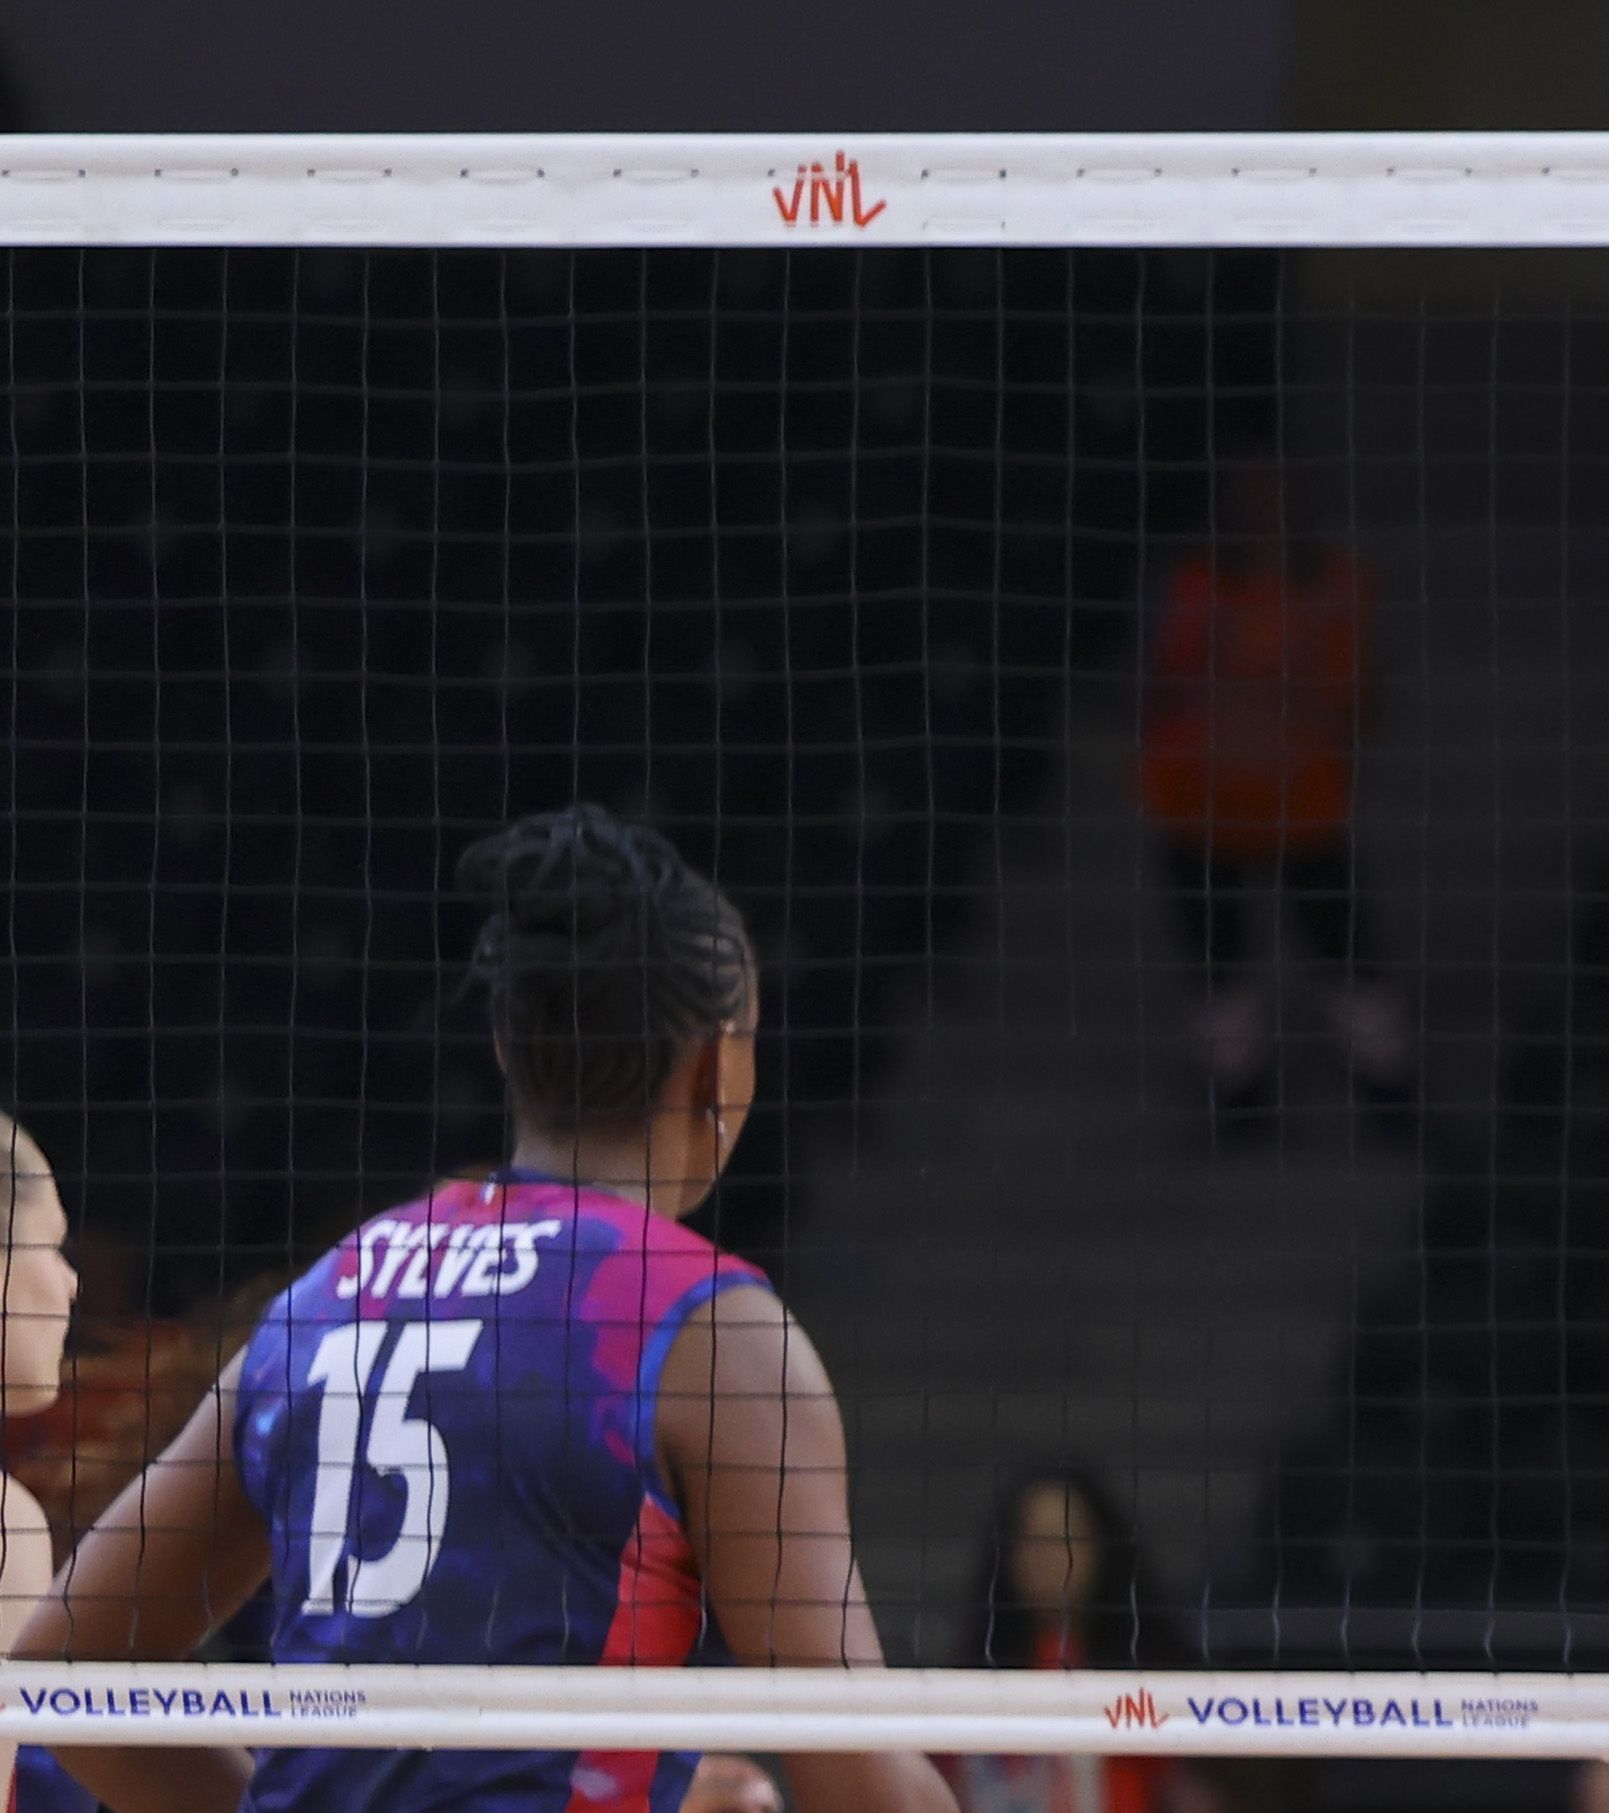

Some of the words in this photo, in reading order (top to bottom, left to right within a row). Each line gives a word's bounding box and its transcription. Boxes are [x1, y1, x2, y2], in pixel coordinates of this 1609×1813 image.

[772, 149, 887, 227] VNL
[335, 1219, 561, 1300] SYLVES
[302, 1318, 482, 1618] 15
[19, 1687, 282, 1717] VOLLEYBALL
[289, 1689, 366, 1705] NATIONS
[290, 1704, 358, 1718] LEAGUE
[1104, 1687, 1171, 1730] VNL
[1187, 1697, 1454, 1728] VOLLEYBALL
[1461, 1699, 1539, 1713] NATIONS
